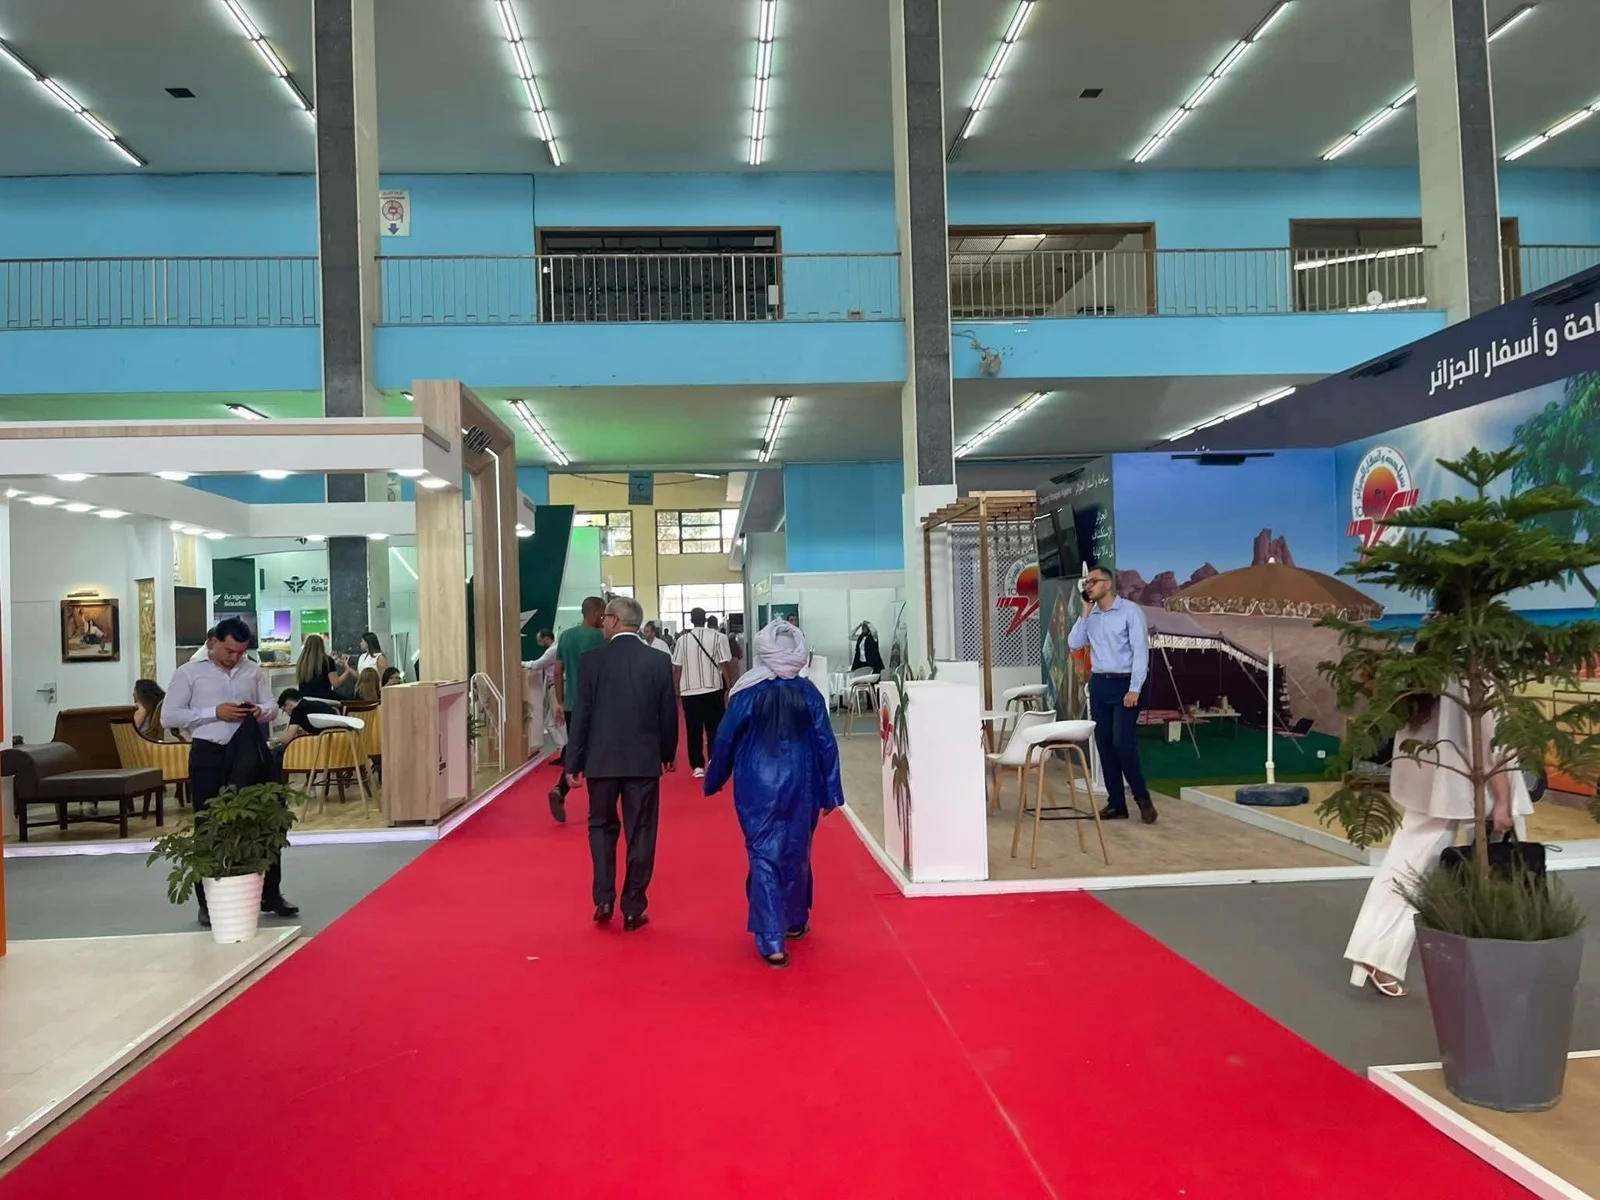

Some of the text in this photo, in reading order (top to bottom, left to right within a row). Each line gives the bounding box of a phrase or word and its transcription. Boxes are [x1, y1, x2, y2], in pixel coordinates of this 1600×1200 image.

[1484, 317, 1539, 378] أسفار
[1544, 327, 1558, 357] و
[1428, 347, 1479, 396] الجزائر
